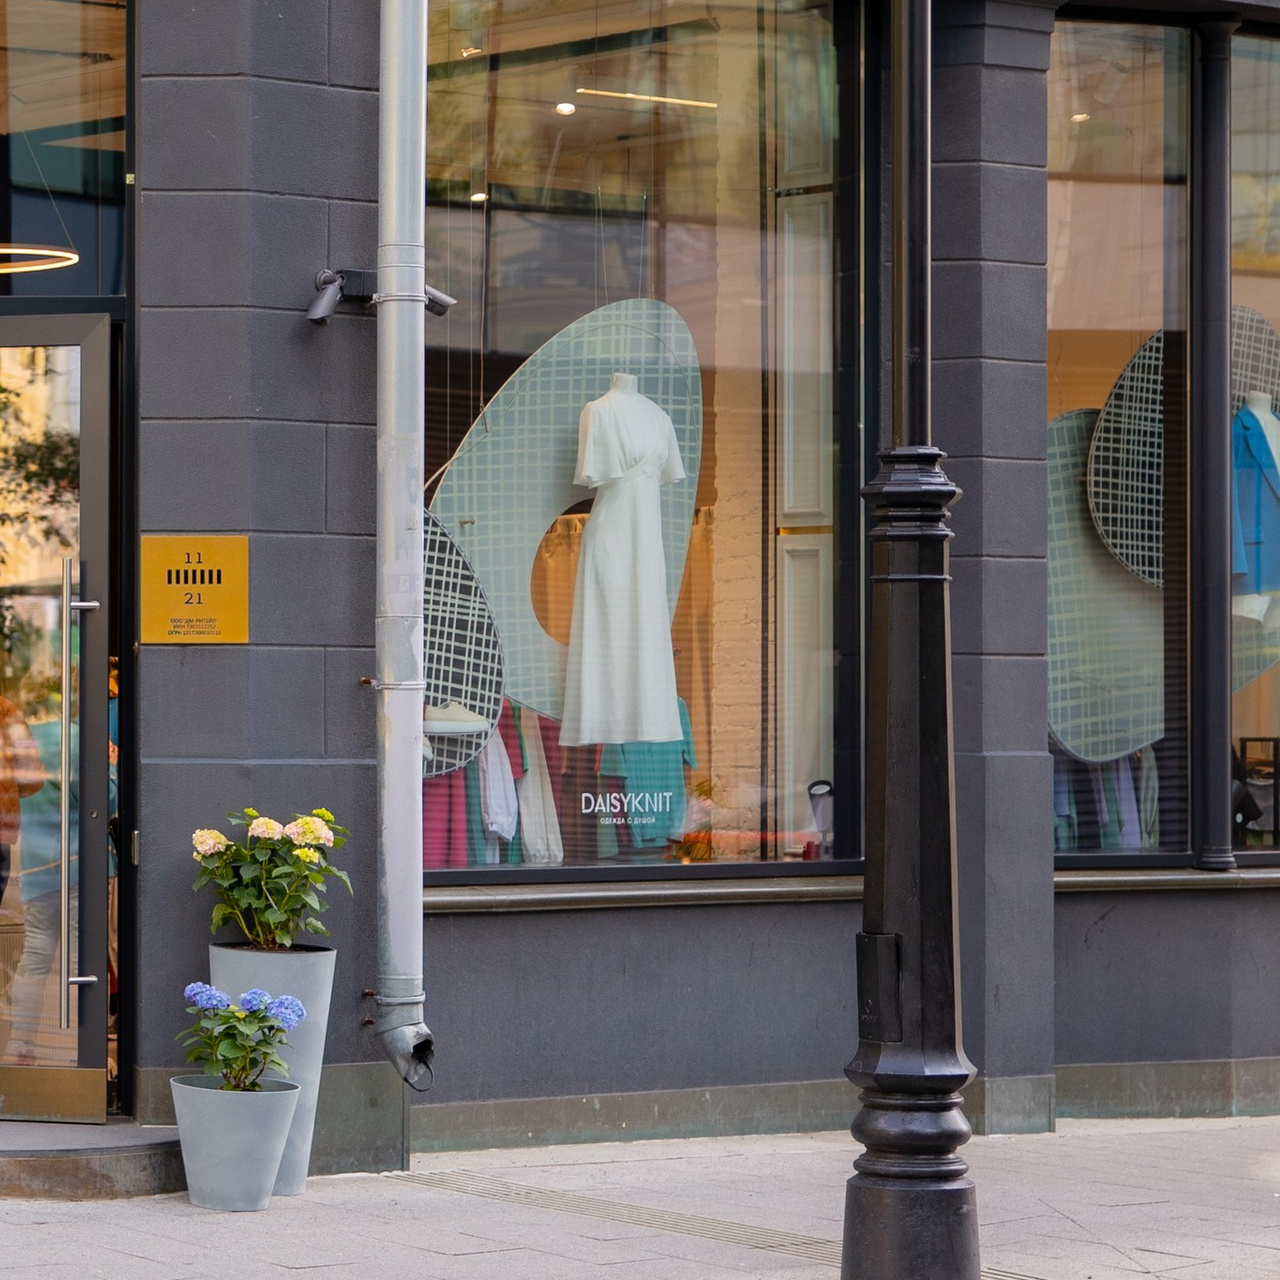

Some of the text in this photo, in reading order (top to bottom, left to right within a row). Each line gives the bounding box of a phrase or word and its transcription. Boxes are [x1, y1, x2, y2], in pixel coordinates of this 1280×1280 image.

[185, 552, 203, 564] 11
[184, 593, 203, 605] 21
[581, 792, 673, 813] DAISYKNIT
[634, 816, 656, 824] ДУШОЙ
